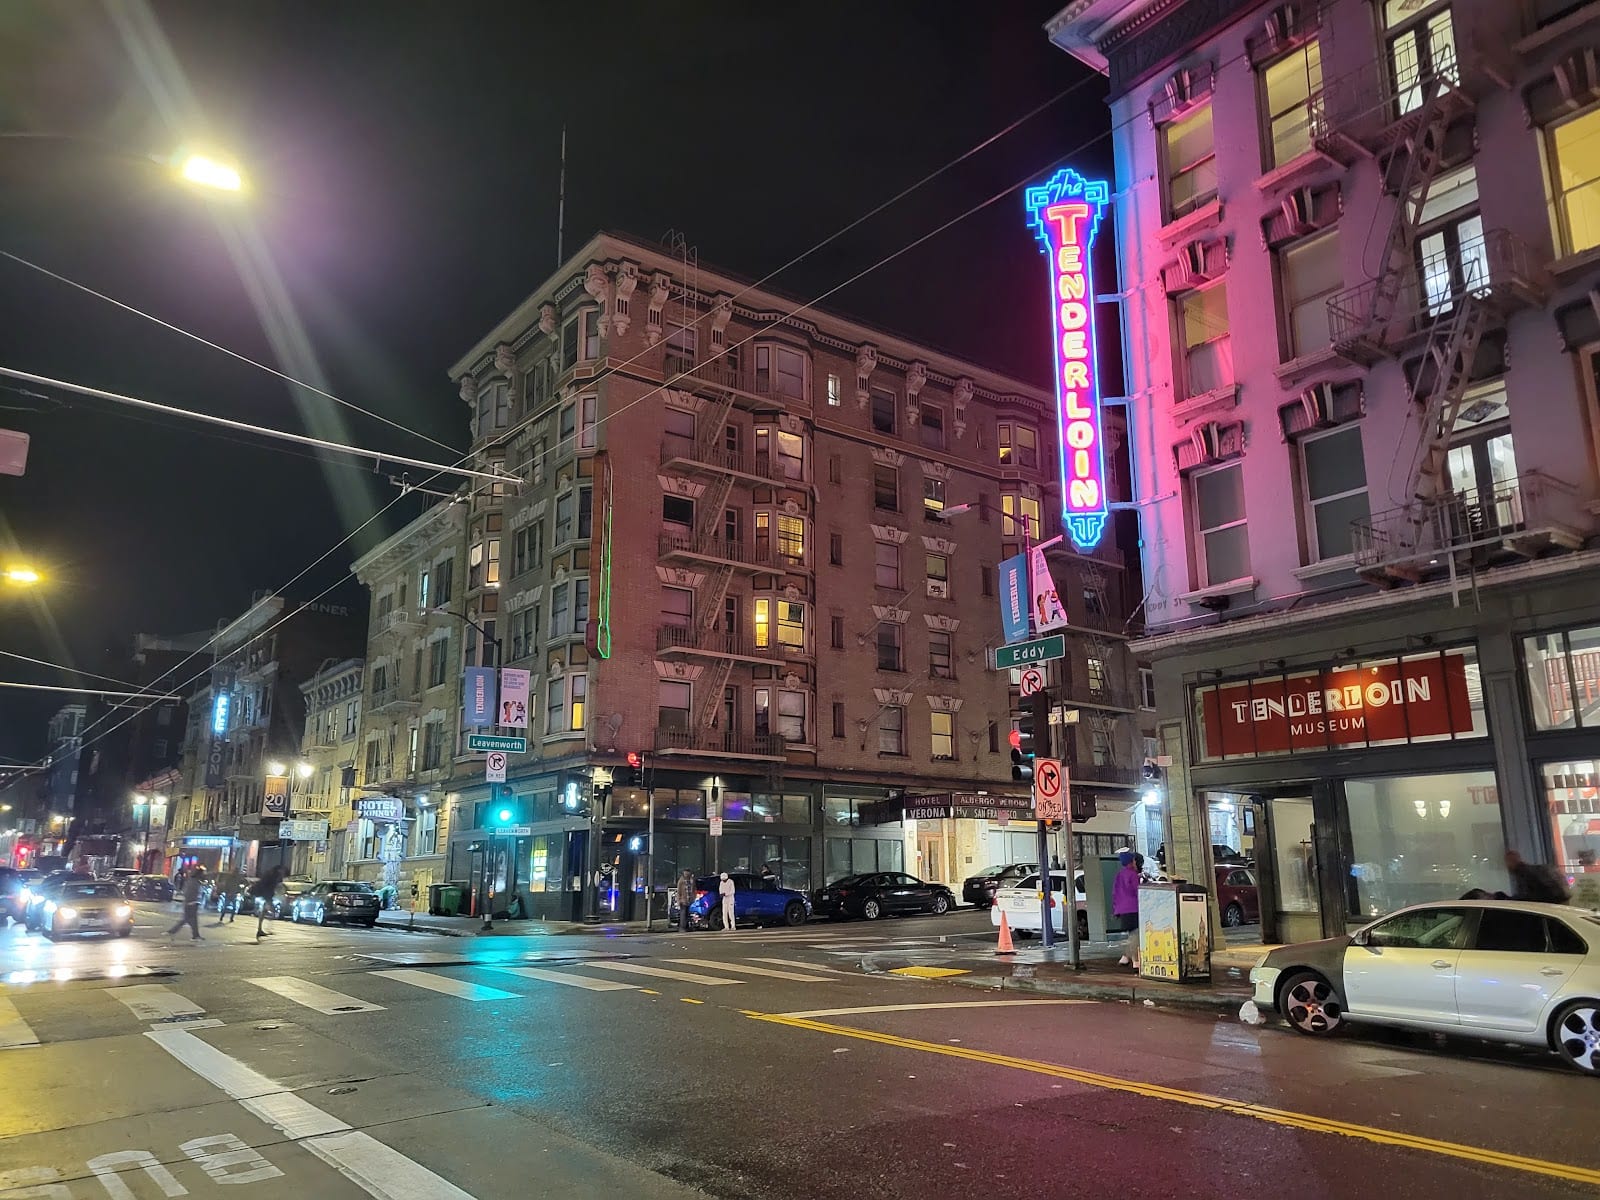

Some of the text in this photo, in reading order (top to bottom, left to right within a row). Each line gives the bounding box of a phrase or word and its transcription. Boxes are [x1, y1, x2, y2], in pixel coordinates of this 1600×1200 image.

[1049, 173, 1083, 203] The
[1047, 204, 1099, 507] TENDERLOIN
[1013, 646, 1045, 661] Eddy
[475, 674, 485, 714] TENDERLOIN
[1231, 676, 1431, 724] TENDERLOIN
[1290, 716, 1366, 736] MUSEUM
[472, 737, 522, 750] Leavenworth
[265, 794, 284, 807] 20
[358, 800, 397, 810] HOTEL
[915, 796, 941, 805] HOTEL
[960, 796, 995, 806] ALBERGO
[910, 807, 946, 819] VERONA
[974, 808, 986, 818] SAN
[987, 809, 1017, 820] FRASCO
[187, 838, 229, 846] JEFFERSON
